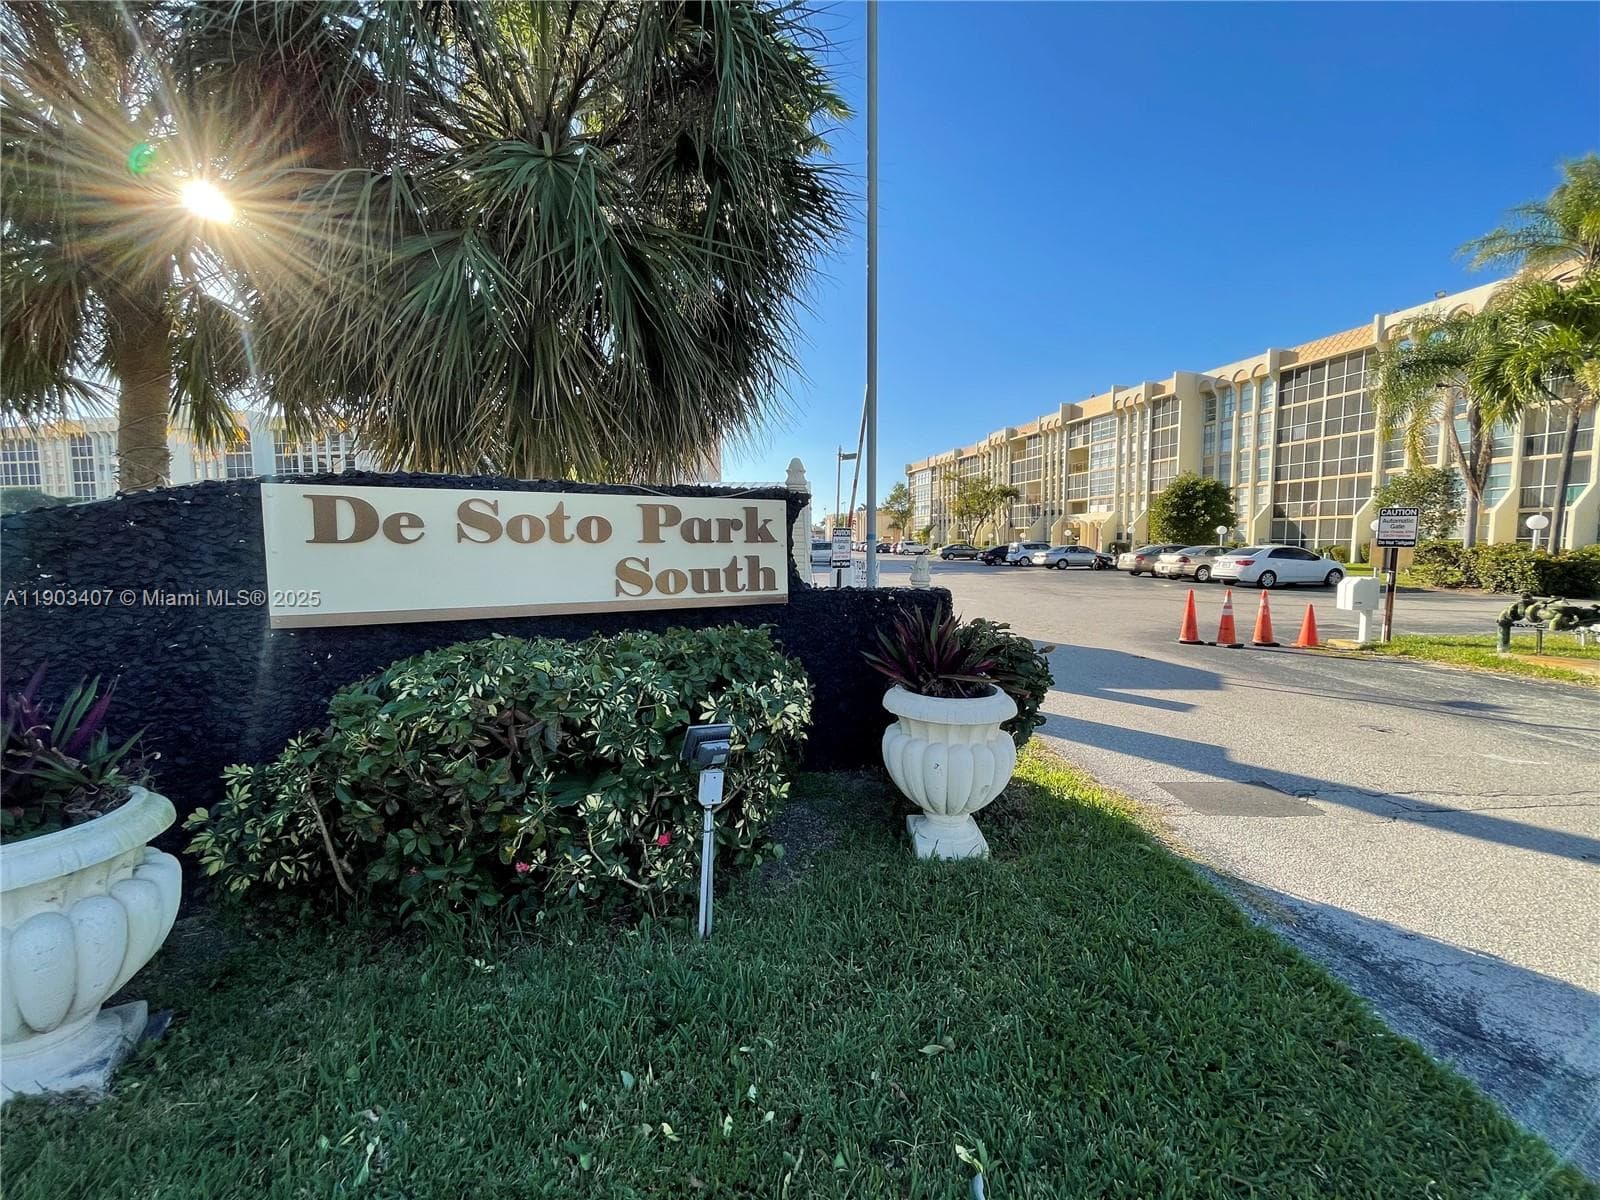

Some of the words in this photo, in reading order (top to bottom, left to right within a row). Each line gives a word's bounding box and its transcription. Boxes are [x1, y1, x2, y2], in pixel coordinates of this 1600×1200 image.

[303, 494, 426, 545] De
[456, 498, 613, 545] Soto
[636, 503, 779, 545] Park
[615, 554, 780, 598] South
